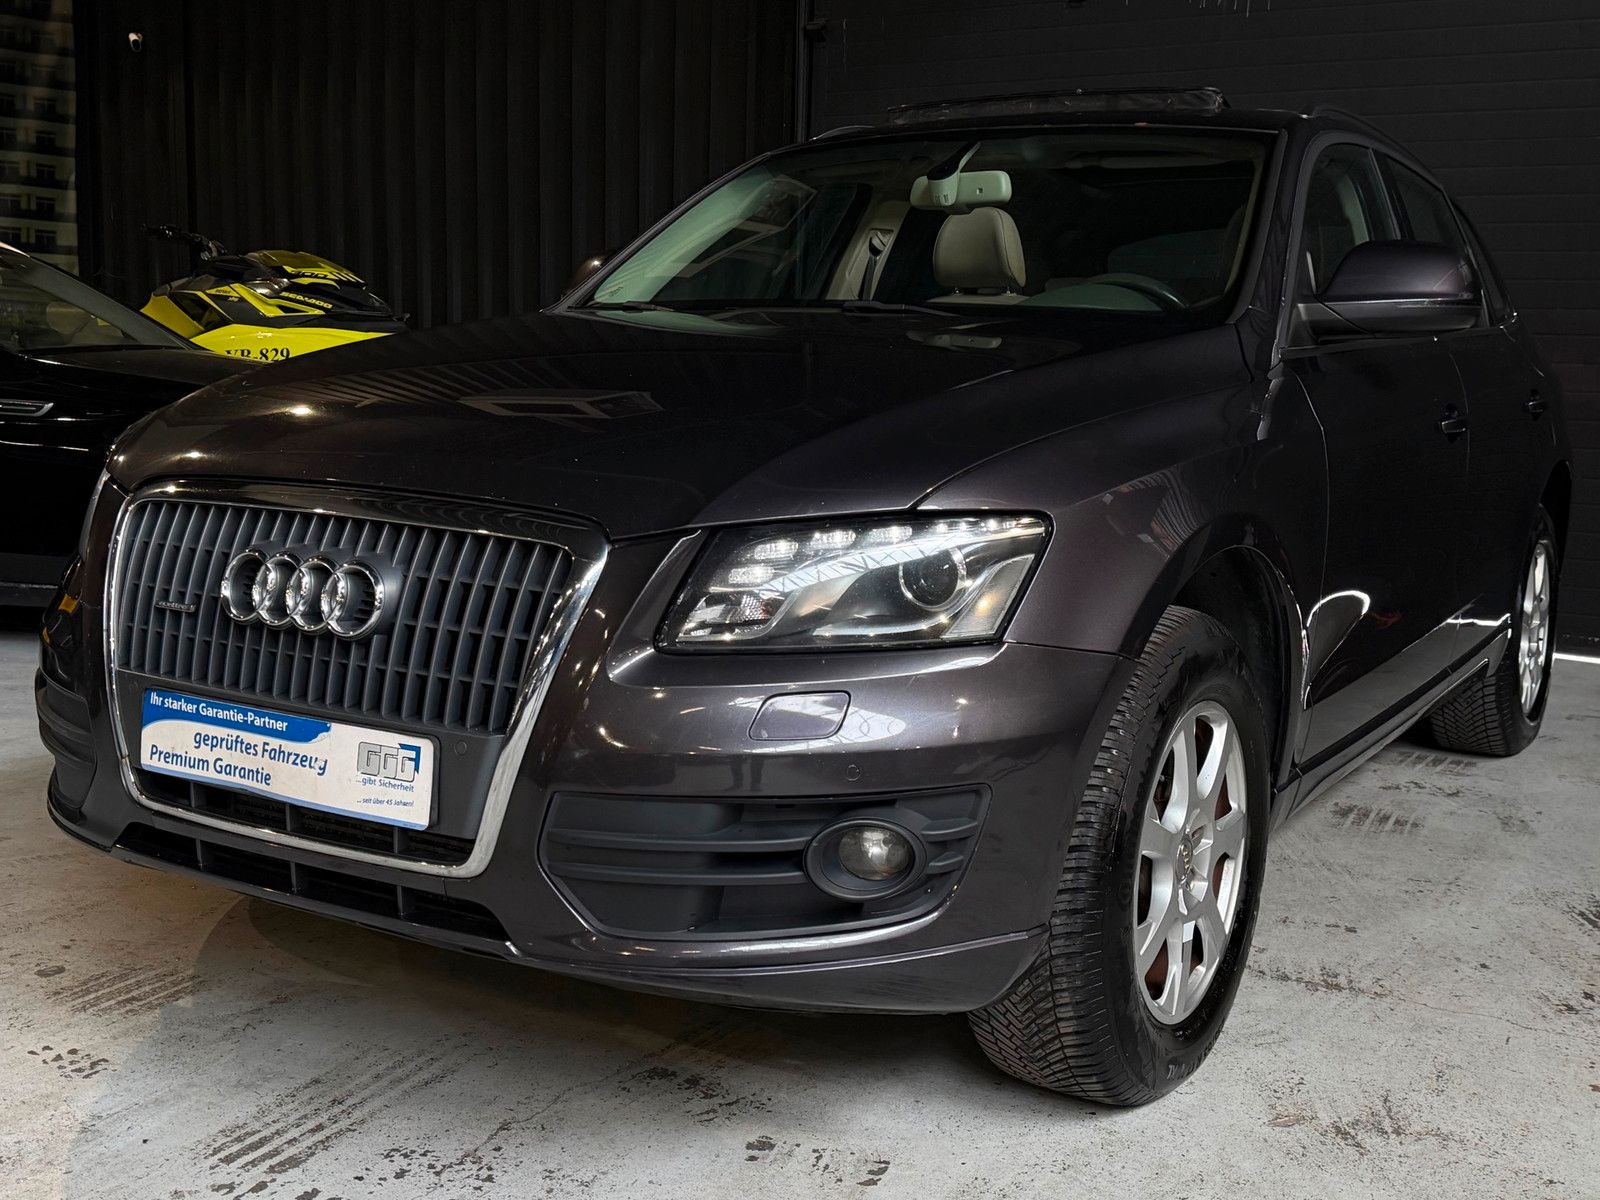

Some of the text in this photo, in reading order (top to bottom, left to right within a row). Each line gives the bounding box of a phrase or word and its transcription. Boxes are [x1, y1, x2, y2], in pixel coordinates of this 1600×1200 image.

[150, 692, 288, 732] Ihr starker Garantie-Partner
[194, 732, 258, 757] geprüftes
[150, 744, 271, 786] Premium Garantie
[379, 778, 415, 793] Sicherheit
